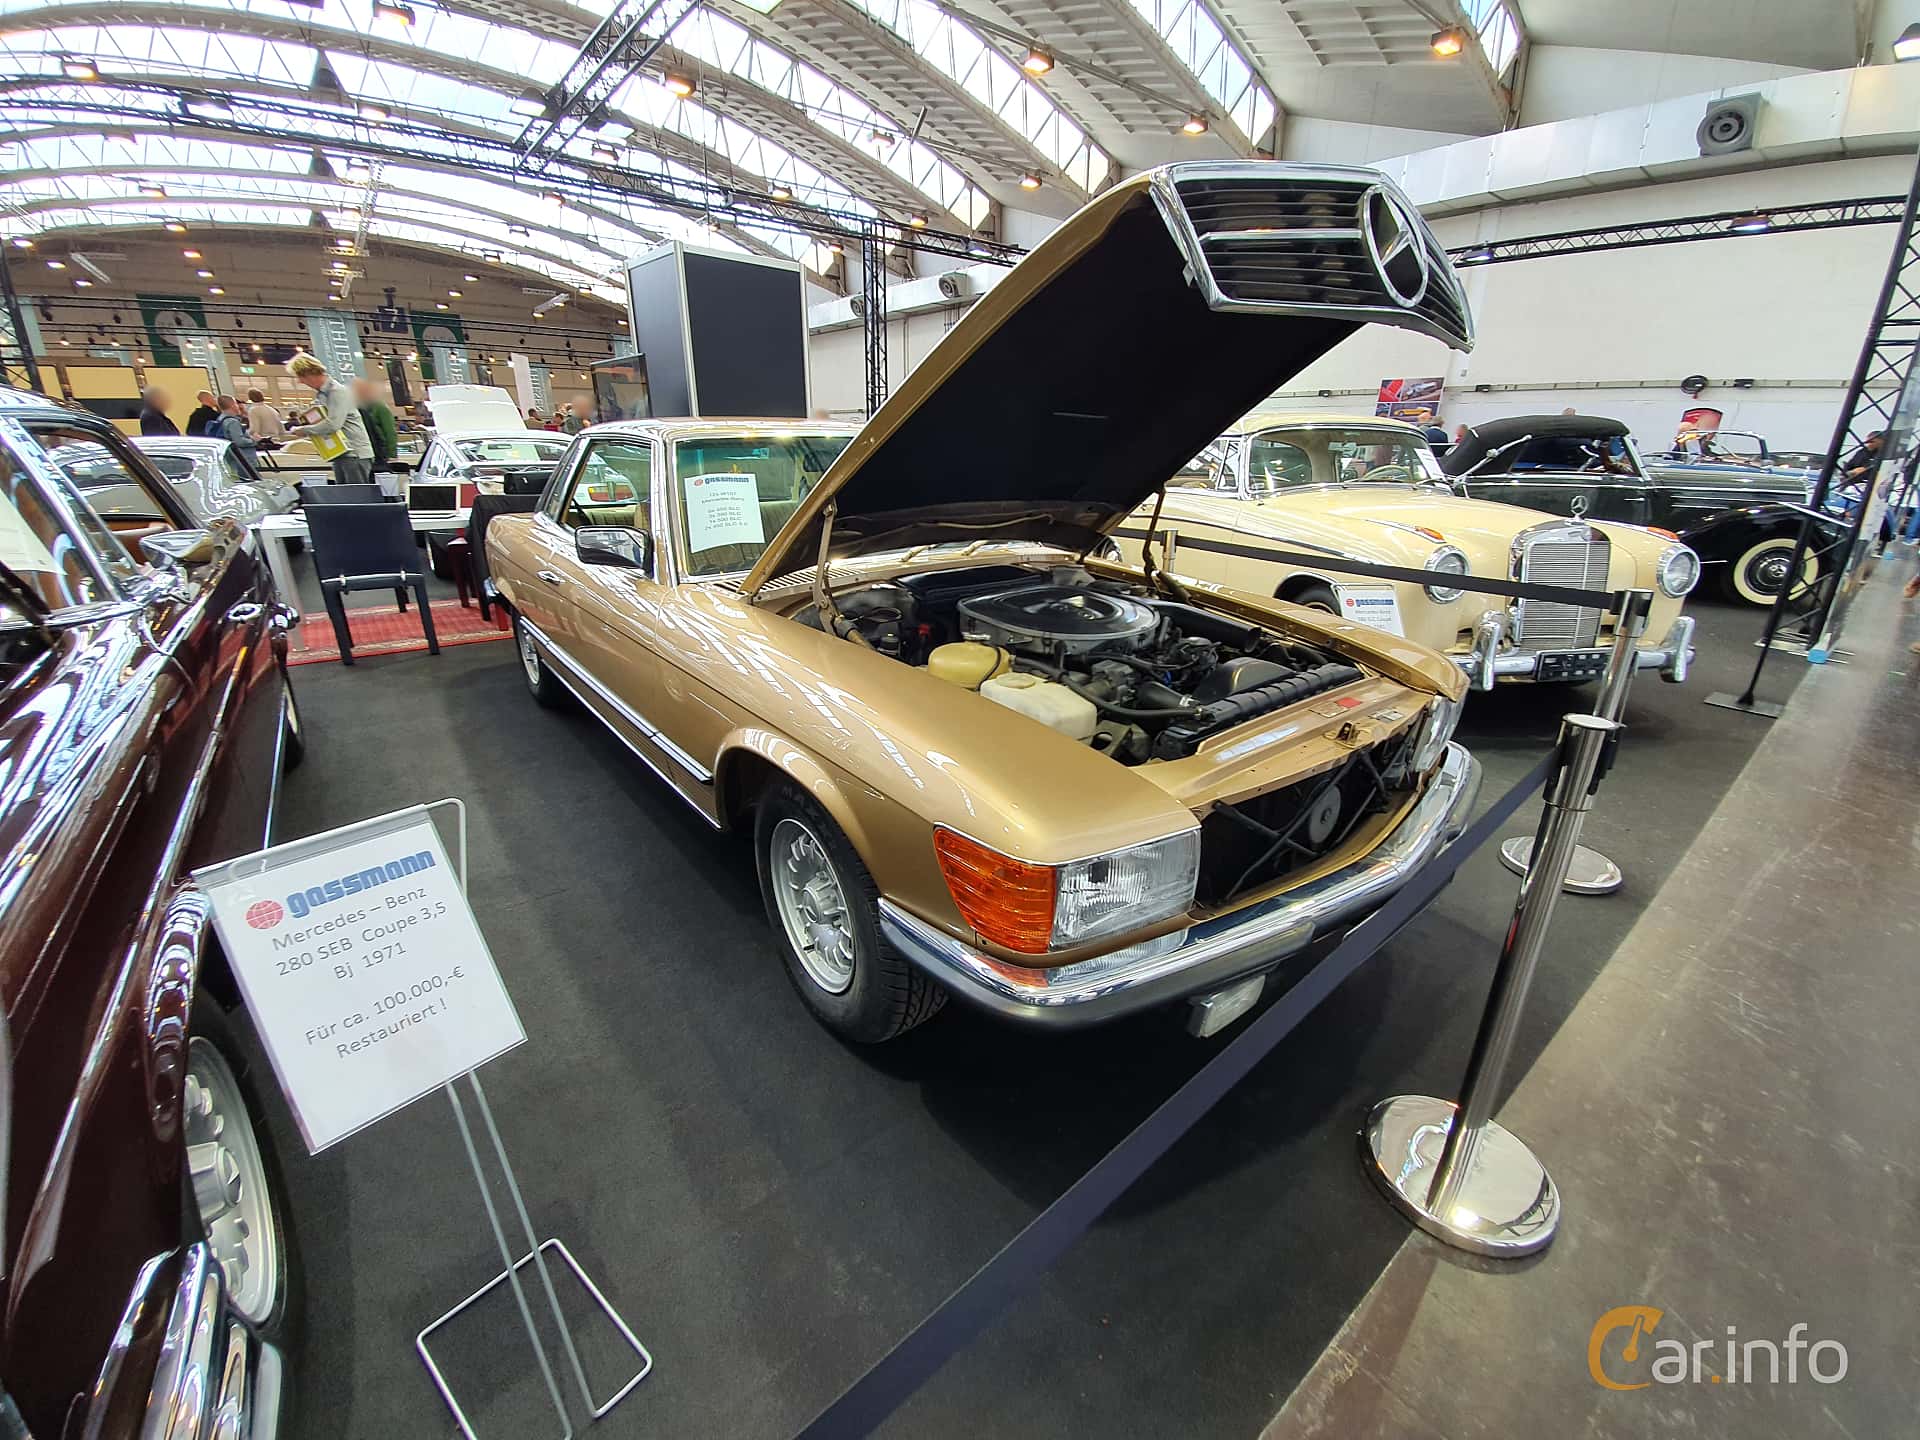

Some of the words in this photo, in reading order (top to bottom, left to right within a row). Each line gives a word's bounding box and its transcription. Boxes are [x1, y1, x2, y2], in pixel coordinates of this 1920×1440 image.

[286, 850, 437, 919] gassmann
[272, 908, 367, 951] Mercedes
[384, 887, 428, 910] Benz
[275, 952, 314, 976] 280
[317, 936, 353, 961] SEB
[361, 914, 418, 943] Coupe
[419, 900, 447, 921] 3,5
[333, 961, 355, 980] Bj
[360, 941, 407, 968] 1971
[305, 1022, 338, 1045] Für
[342, 1012, 370, 1030] ca.
[373, 965, 465, 1016] 100.000,-€
[336, 1004, 437, 1059] Restauriert
